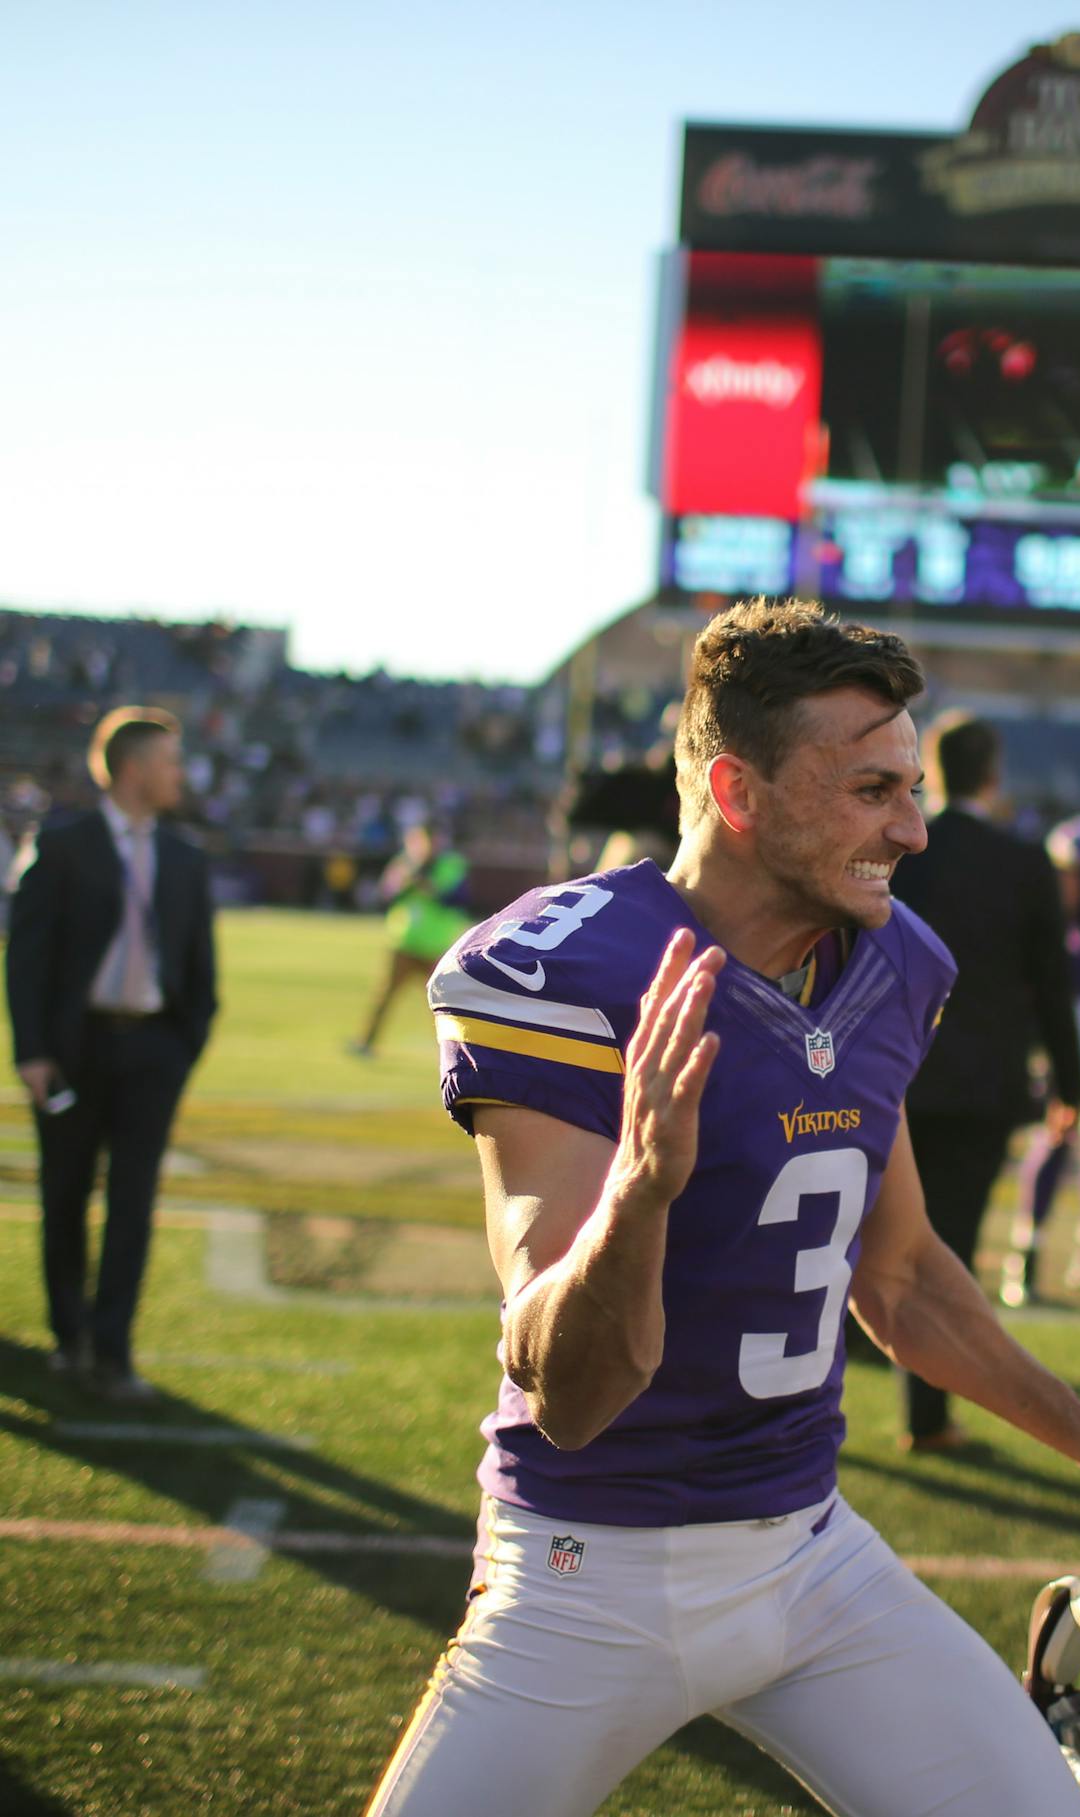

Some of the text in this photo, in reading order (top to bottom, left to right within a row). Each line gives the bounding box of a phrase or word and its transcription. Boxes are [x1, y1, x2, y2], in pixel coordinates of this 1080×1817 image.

[491, 884, 614, 950] 3
[811, 1048, 833, 1069] NFL
[738, 1147, 869, 1400] 3
[550, 1550, 577, 1571] NFL
